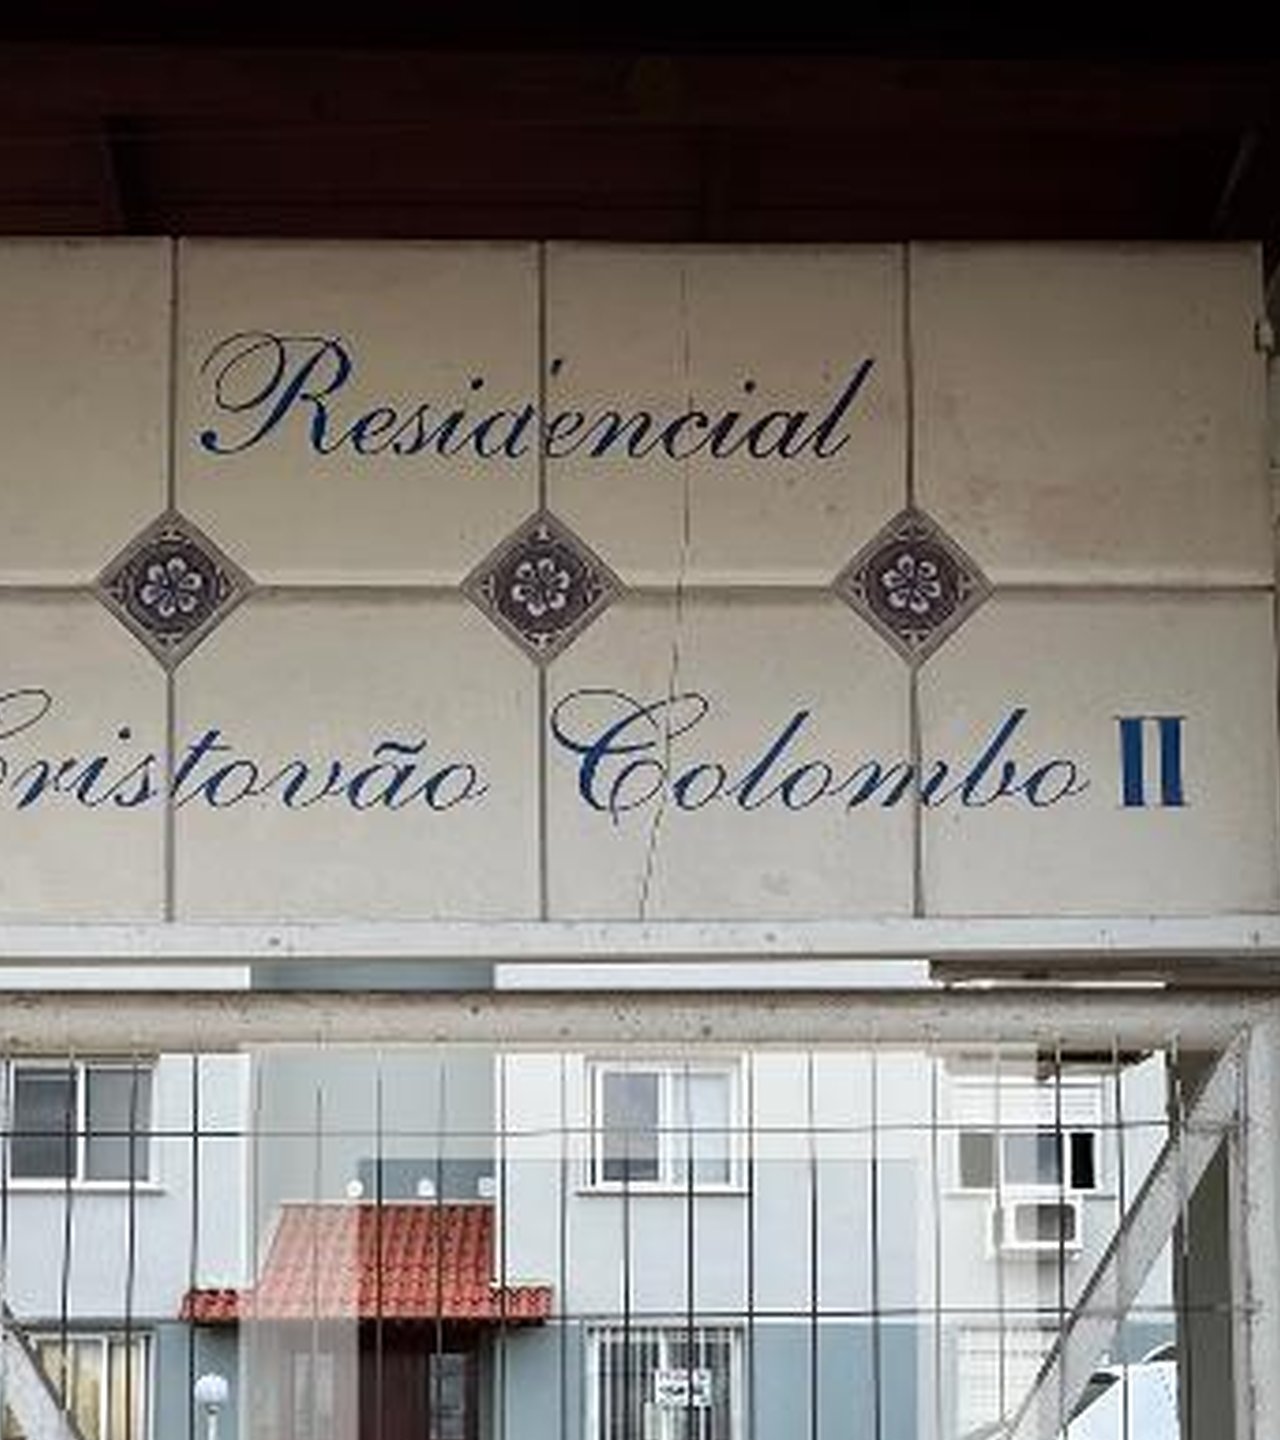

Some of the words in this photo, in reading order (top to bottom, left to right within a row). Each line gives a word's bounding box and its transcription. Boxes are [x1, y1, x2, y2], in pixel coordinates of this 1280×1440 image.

[198, 332, 878, 462] Residencial
[550, 688, 1092, 826] Colombo
[1114, 716, 1188, 808] II
